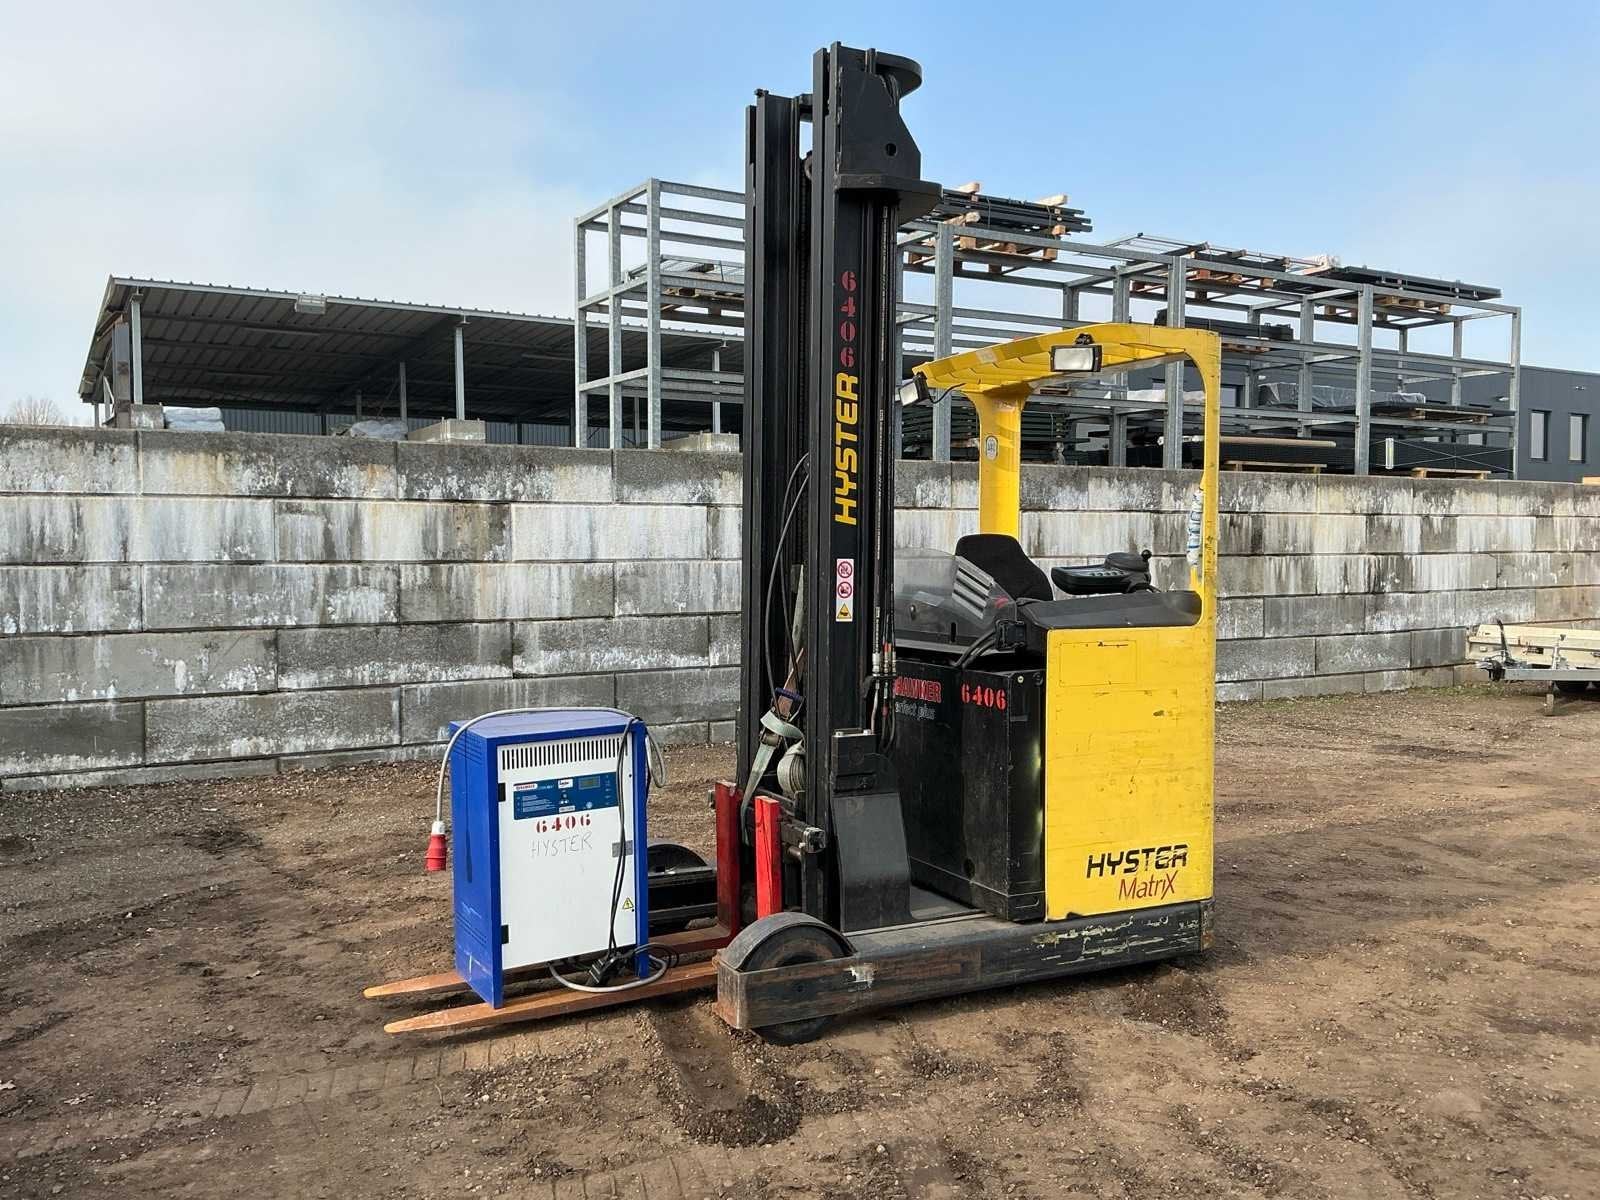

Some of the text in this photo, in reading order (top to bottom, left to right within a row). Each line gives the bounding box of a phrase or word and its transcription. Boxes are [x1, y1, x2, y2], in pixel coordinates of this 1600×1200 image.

[841, 271, 856, 367] 6406
[834, 372, 858, 525] HYSTER
[961, 682, 1008, 711] 6406
[536, 813, 592, 833] 6406
[530, 831, 593, 859] HYSTER
[1086, 844, 1189, 879] HYSTER
